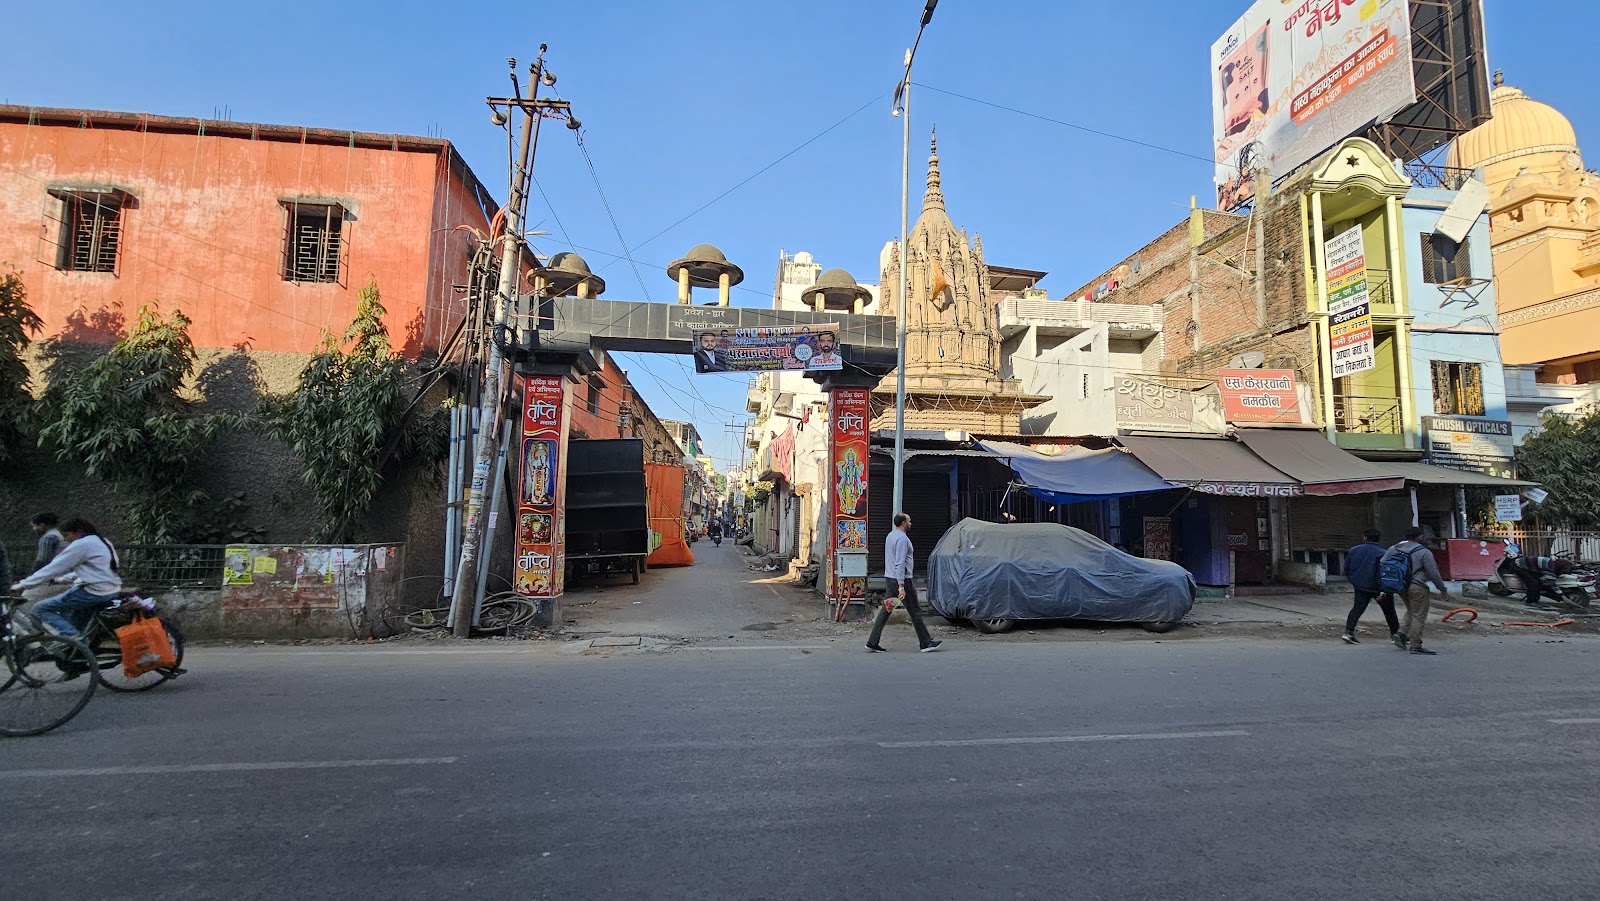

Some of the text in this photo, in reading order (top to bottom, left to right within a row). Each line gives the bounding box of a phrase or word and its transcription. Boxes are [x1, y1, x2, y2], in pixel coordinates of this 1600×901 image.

[1221, 37, 1238, 58] NANDI
[1344, 59, 1355, 71] का
[1366, 58, 1375, 71] का
[1378, 44, 1394, 64] स्वाद
[1239, 65, 1254, 82] SALT
[684, 307, 704, 316] प्रवेश
[1334, 306, 1364, 323] स्टेशनरी
[674, 319, 684, 328] माँ
[686, 321, 708, 330] काली
[1352, 343, 1362, 355] कार्ड
[1346, 356, 1366, 372] निकलता
[1225, 376, 1291, 389] एस. केसरवानी
[1117, 378, 1184, 408] शगुन
[1242, 394, 1280, 407] नमकीन
[527, 399, 558, 422] तृप्ति
[1118, 404, 1142, 420] ब्यूटी
[837, 410, 864, 433] तृप्ति
[1433, 419, 1507, 433] KHUSHI OPTICAL'S
[1225, 483, 1260, 496] ब्यूटी
[518, 551, 550, 572] तृप्ति
